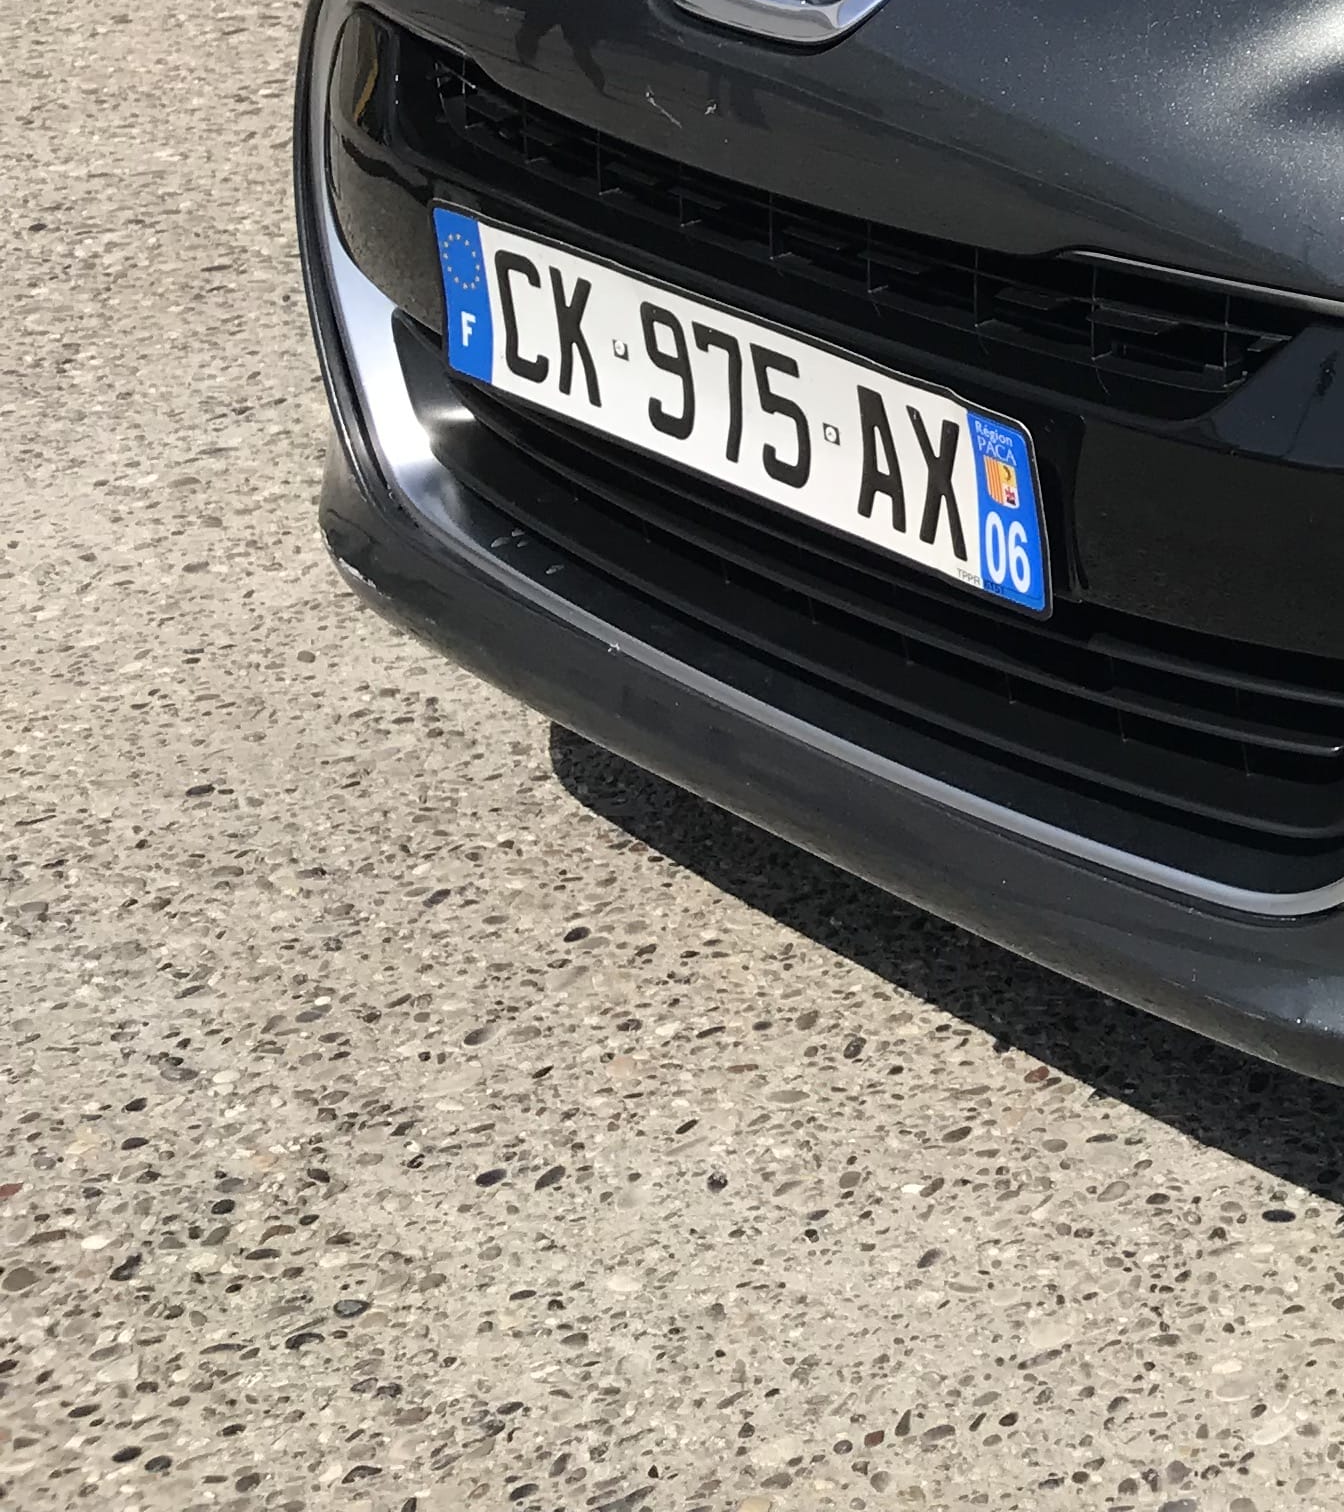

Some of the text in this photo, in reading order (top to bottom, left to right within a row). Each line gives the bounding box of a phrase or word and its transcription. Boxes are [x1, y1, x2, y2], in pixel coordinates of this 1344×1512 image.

[461, 311, 476, 347] F
[975, 420, 1013, 448] Région
[977, 435, 1017, 466] PACA
[985, 510, 1031, 594] 06
